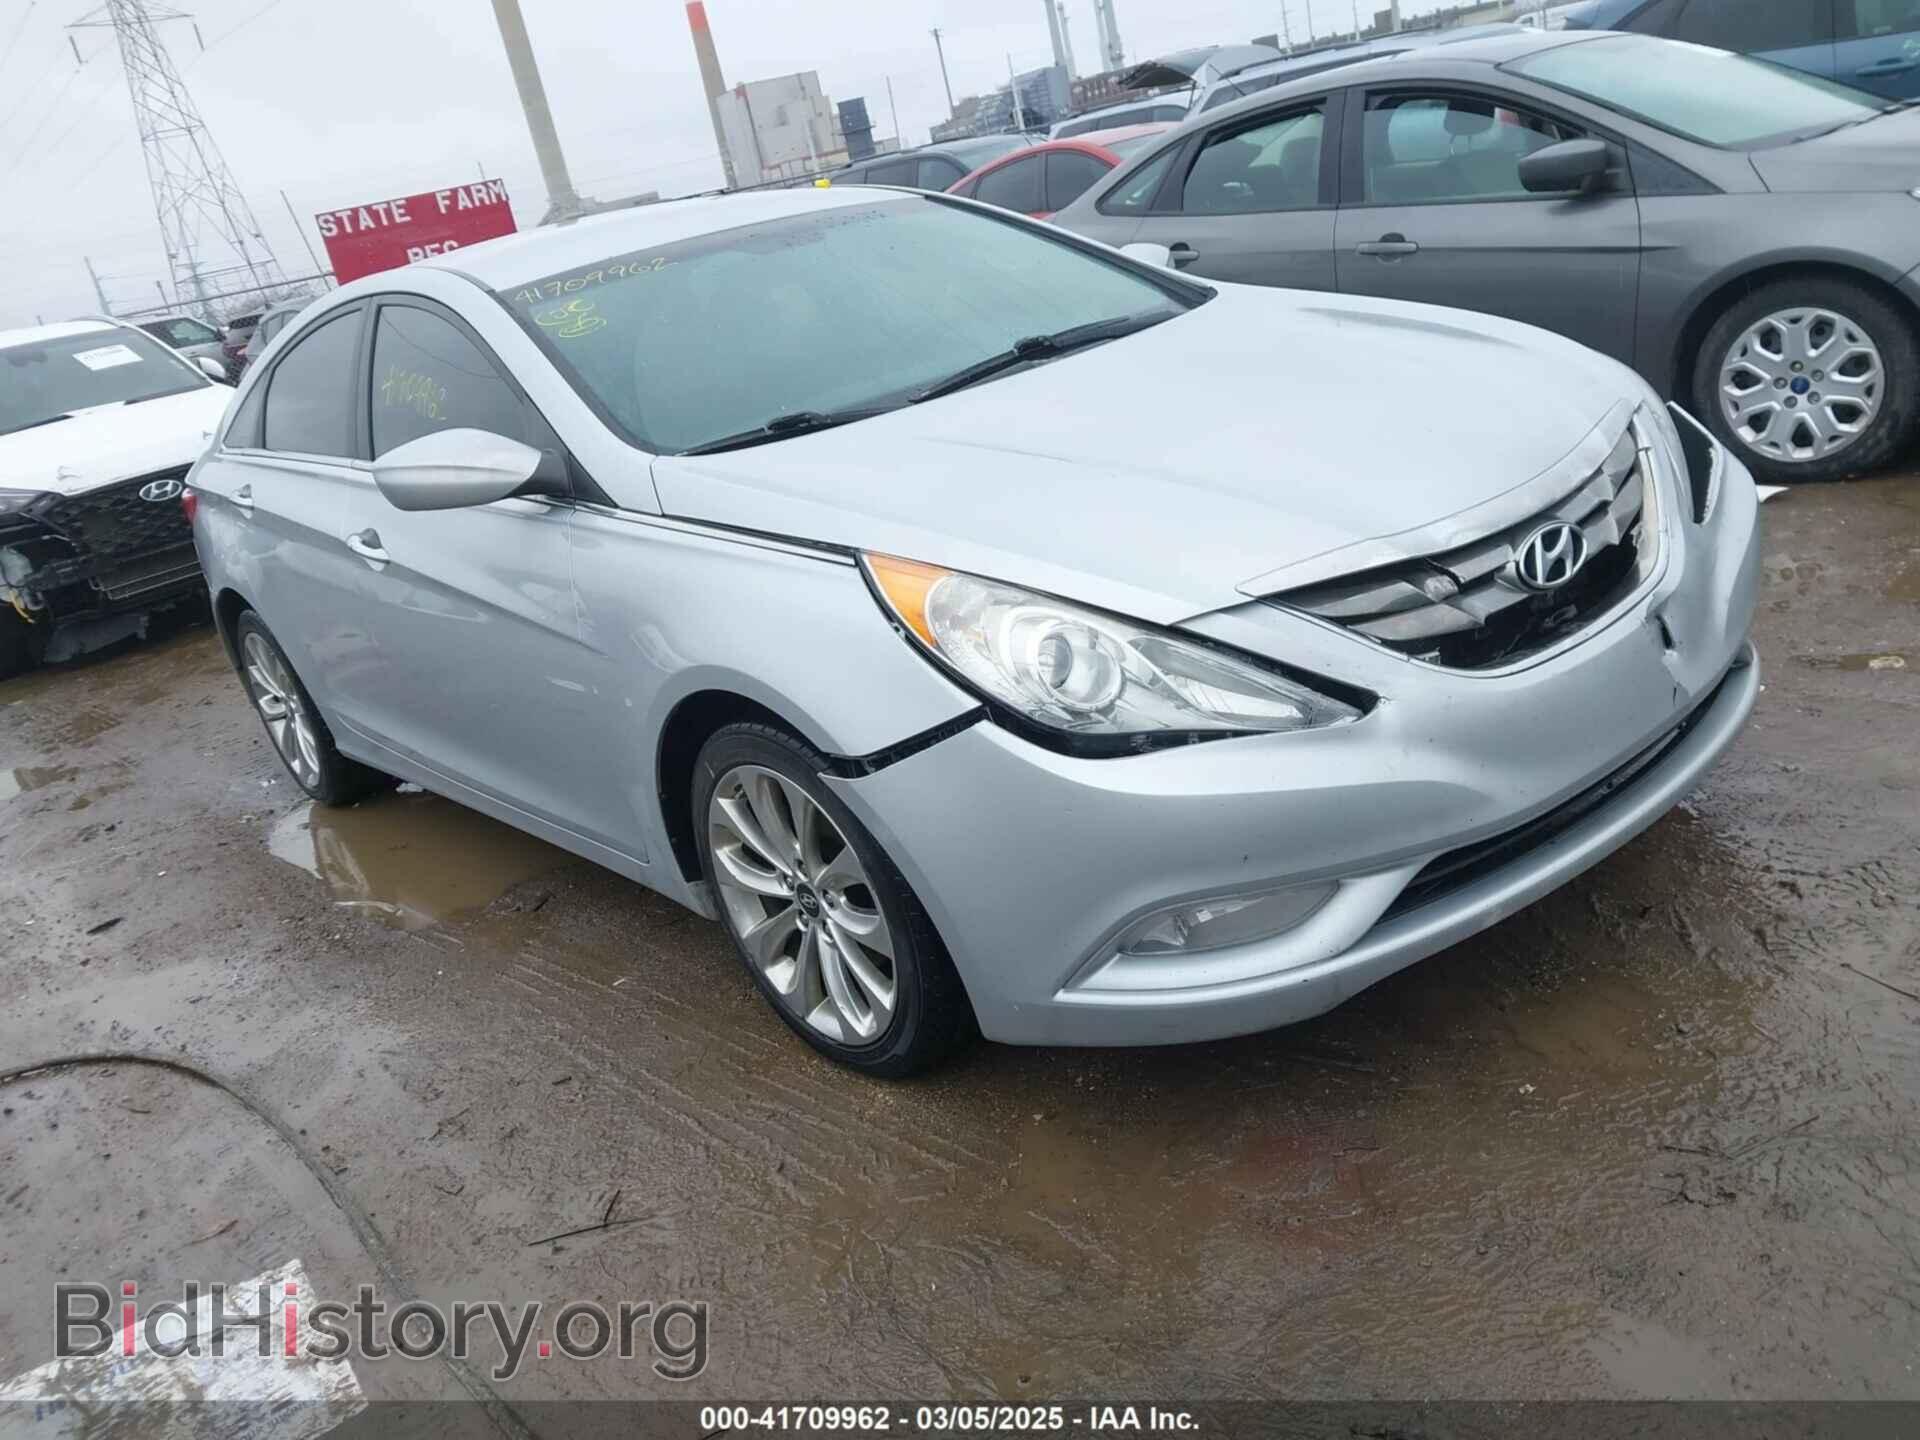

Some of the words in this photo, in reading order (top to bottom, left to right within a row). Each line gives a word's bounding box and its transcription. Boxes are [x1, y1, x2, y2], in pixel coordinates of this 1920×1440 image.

[317, 199, 412, 238] STATE
[434, 179, 509, 215] FARM
[514, 256, 679, 304] 41709962
